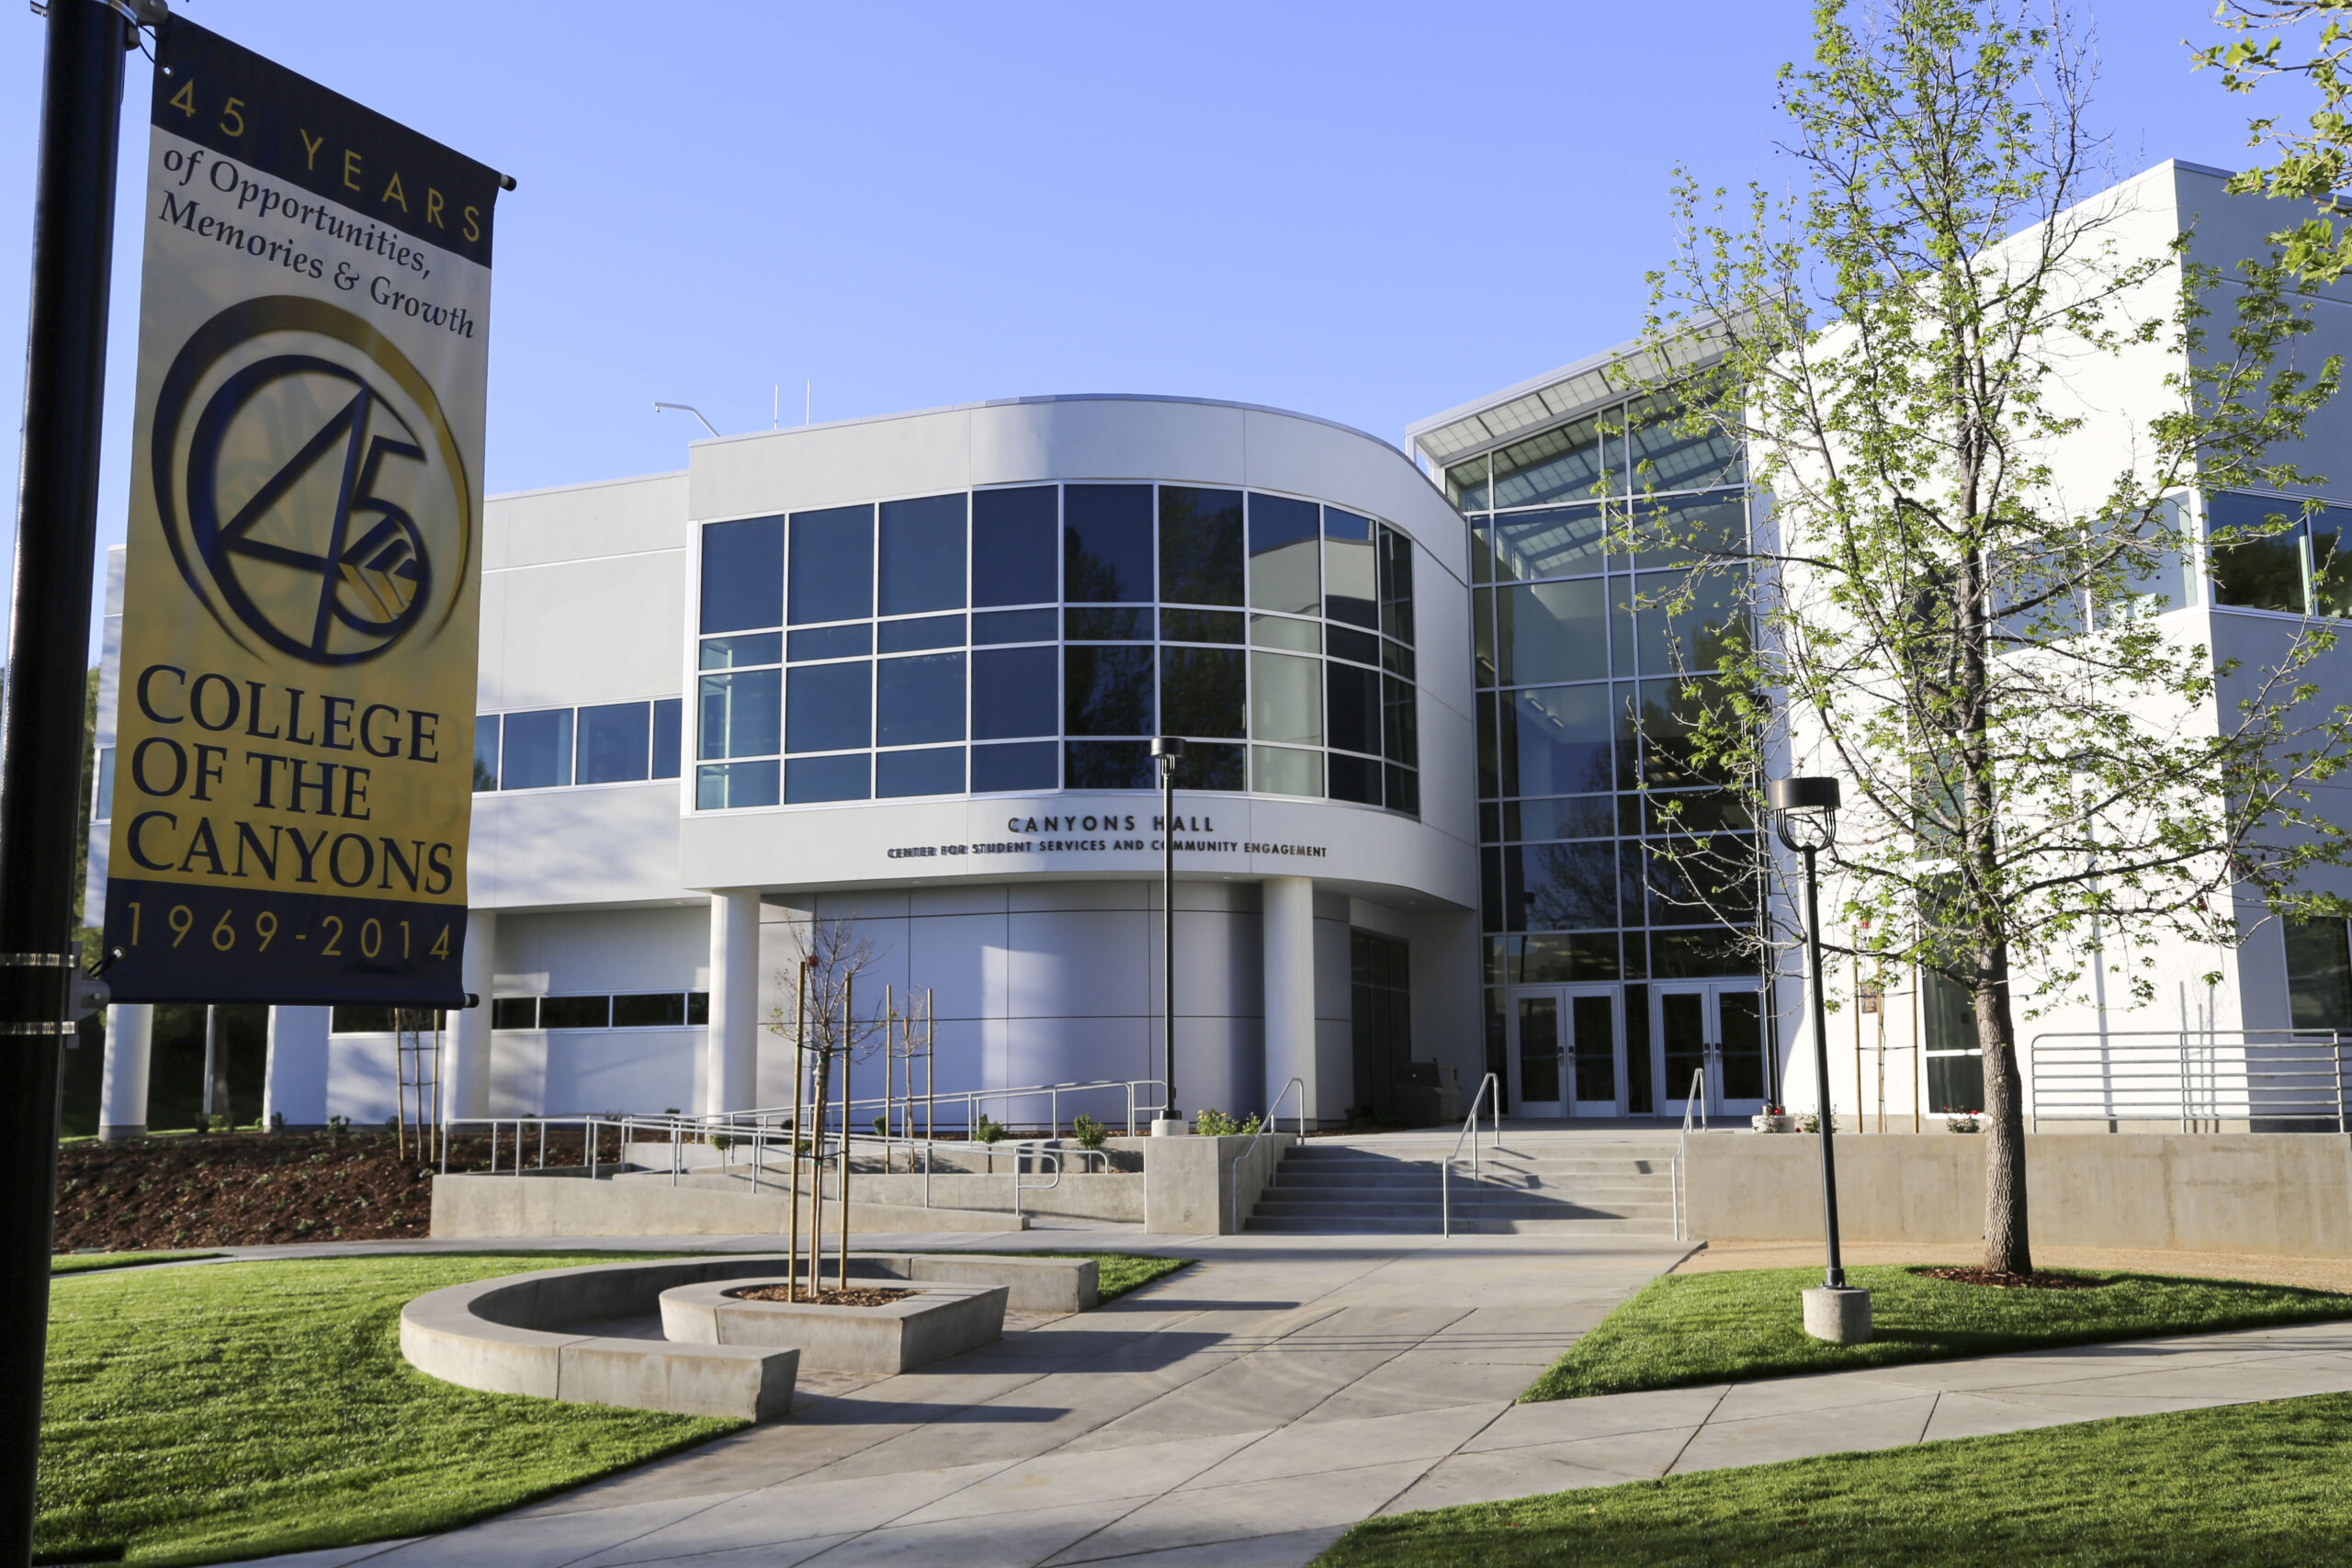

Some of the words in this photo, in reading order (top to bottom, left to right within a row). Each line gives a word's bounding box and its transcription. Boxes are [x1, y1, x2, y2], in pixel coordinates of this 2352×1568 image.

[169, 79, 245, 138] 45
[300, 128, 481, 243] YEARS
[164, 148, 204, 186] of
[209, 160, 431, 279] Opportunities,
[158, 190, 323, 279] Memories
[334, 262, 360, 291] &
[370, 276, 474, 339] Growth
[136, 663, 440, 764] COLLEGE
[131, 737, 228, 802] OF
[245, 750, 371, 821] THE
[127, 810, 453, 896] CANYONS
[888, 846, 936, 859] CENTER
[941, 844, 967, 856] FOR
[971, 841, 1032, 854] STUDENT
[1039, 840, 1106, 852] SERVICES
[1113, 840, 1144, 851] AND
[1244, 842, 1328, 858] ENGAGEMENT
[1008, 815, 1136, 833] CANYONS
[1153, 815, 1214, 832] HALL
[128, 902, 450, 961] 1969-2014
